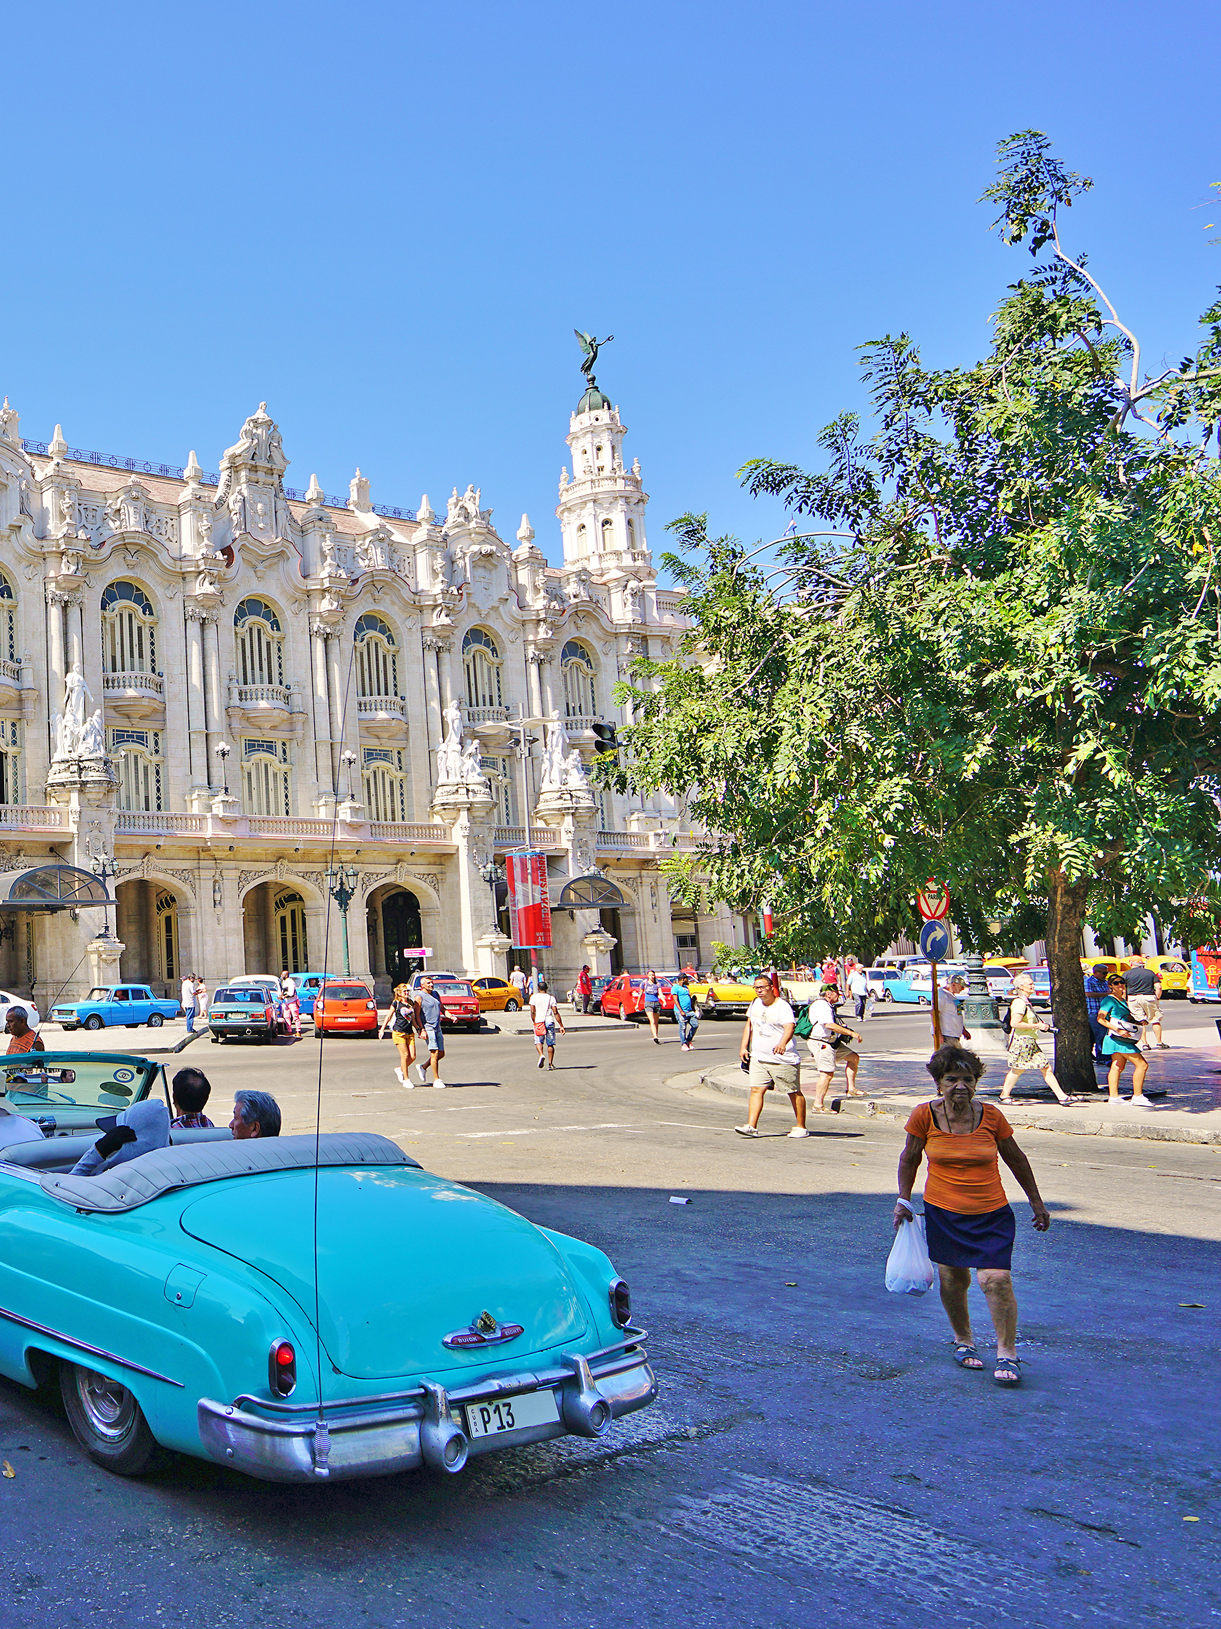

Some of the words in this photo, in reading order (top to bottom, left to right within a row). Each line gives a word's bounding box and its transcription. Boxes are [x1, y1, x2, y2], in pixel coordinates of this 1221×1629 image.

[537, 855, 547, 888] SANGRE
[458, 1336, 478, 1344] BUICK
[505, 1328, 520, 1336] EIGHT
[470, 1408, 479, 1433] CUBA
